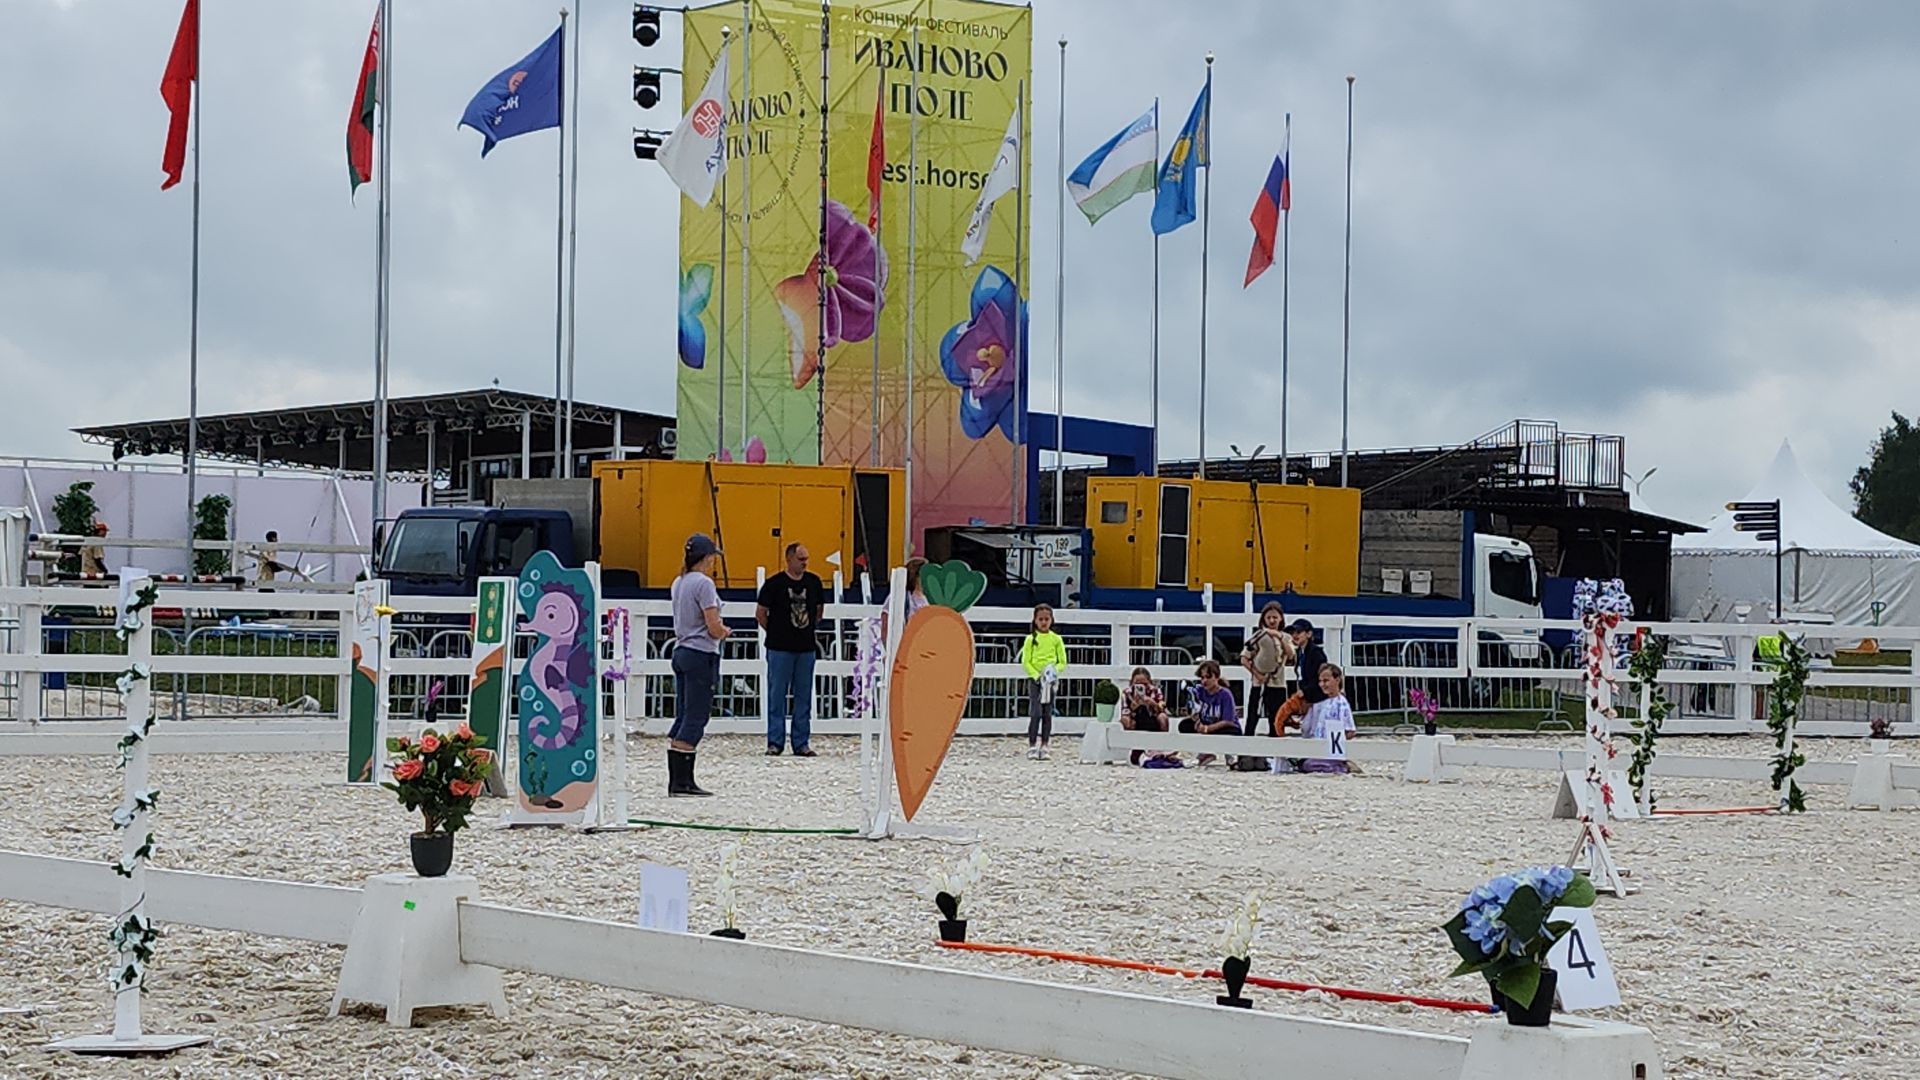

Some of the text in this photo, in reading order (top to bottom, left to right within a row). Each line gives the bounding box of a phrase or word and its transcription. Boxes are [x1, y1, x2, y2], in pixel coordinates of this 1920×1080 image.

[855, 8, 1009, 41] КОННЫЙ ФЕСТИВАЛЬ
[854, 35, 1009, 83] ИВАНОВО
[727, 90, 792, 126] АНОВО
[891, 82, 974, 121] ПОЛЕ
[727, 129, 774, 161] ПОЛЕ
[1330, 731, 1344, 755] K
[1567, 928, 1596, 980] 4
